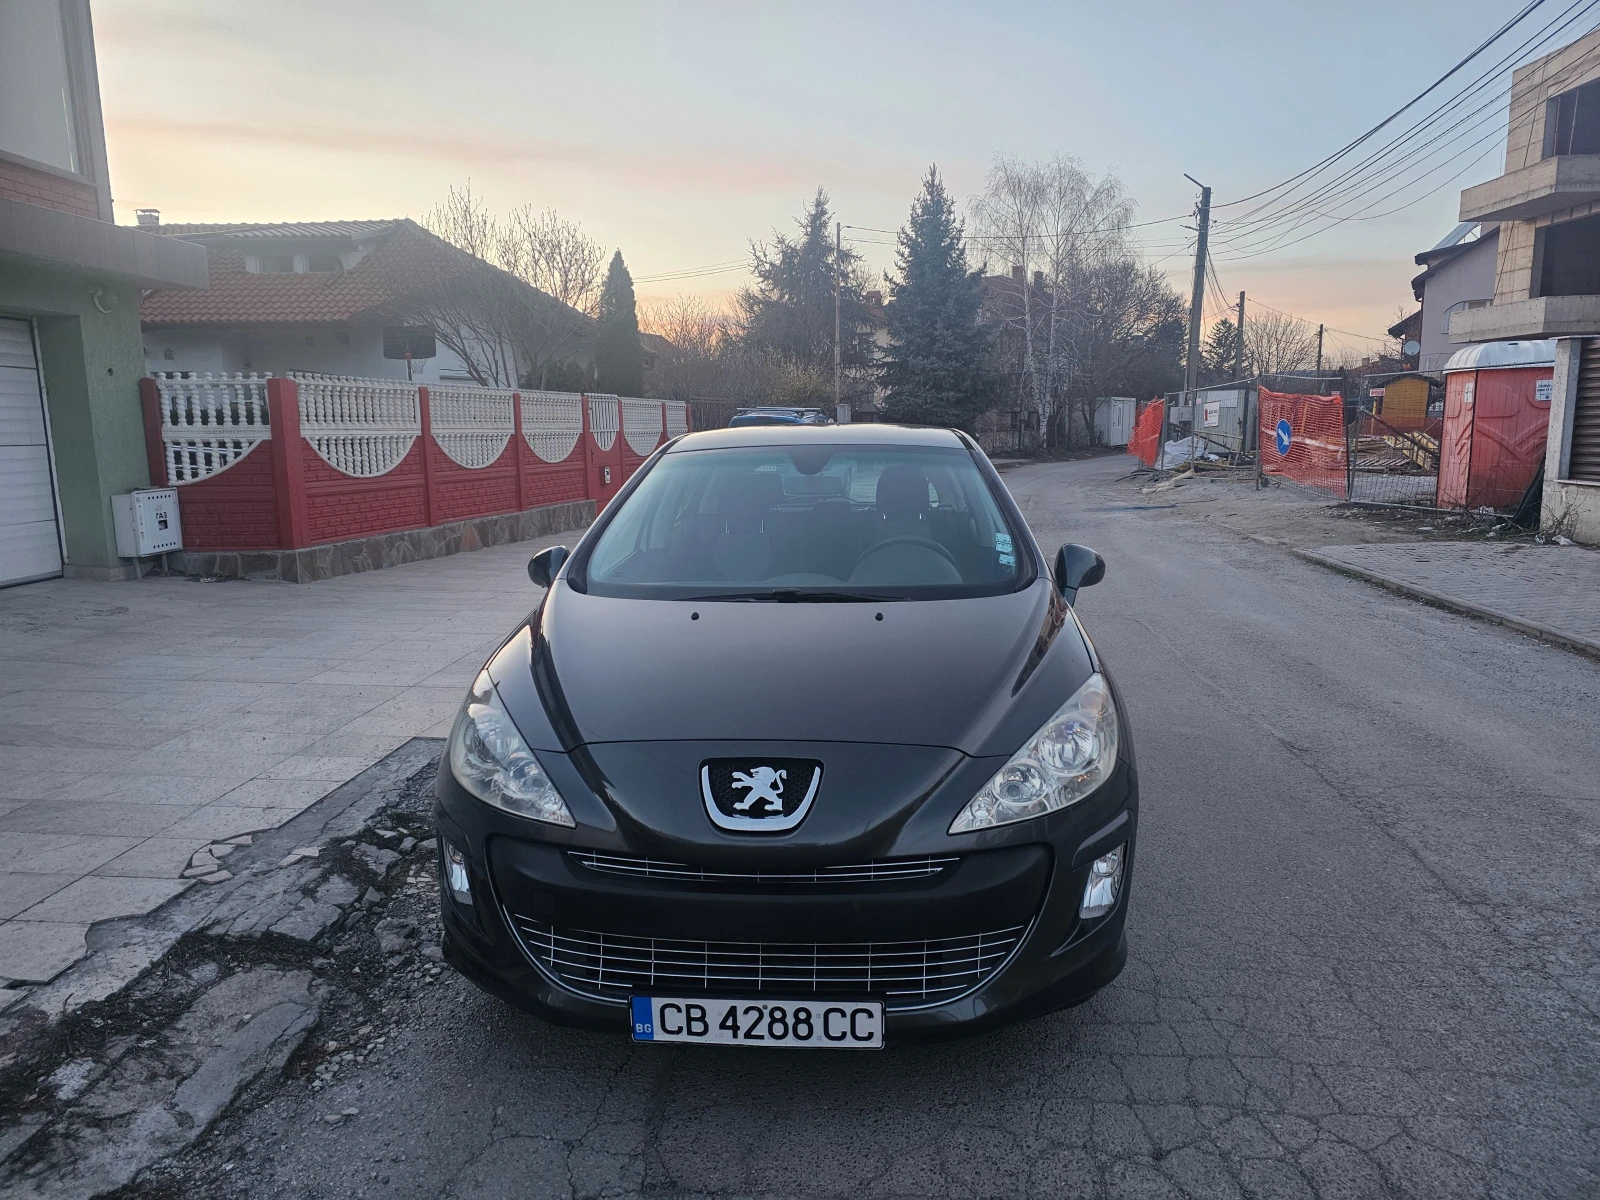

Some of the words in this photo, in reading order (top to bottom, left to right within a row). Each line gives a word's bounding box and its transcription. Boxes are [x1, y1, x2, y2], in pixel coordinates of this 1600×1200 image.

[156, 511, 168, 519] ГАЗ
[659, 1002, 709, 1037] CB
[719, 1005, 814, 1041] 4288
[823, 1007, 875, 1042] CC
[636, 1023, 652, 1034] BG
